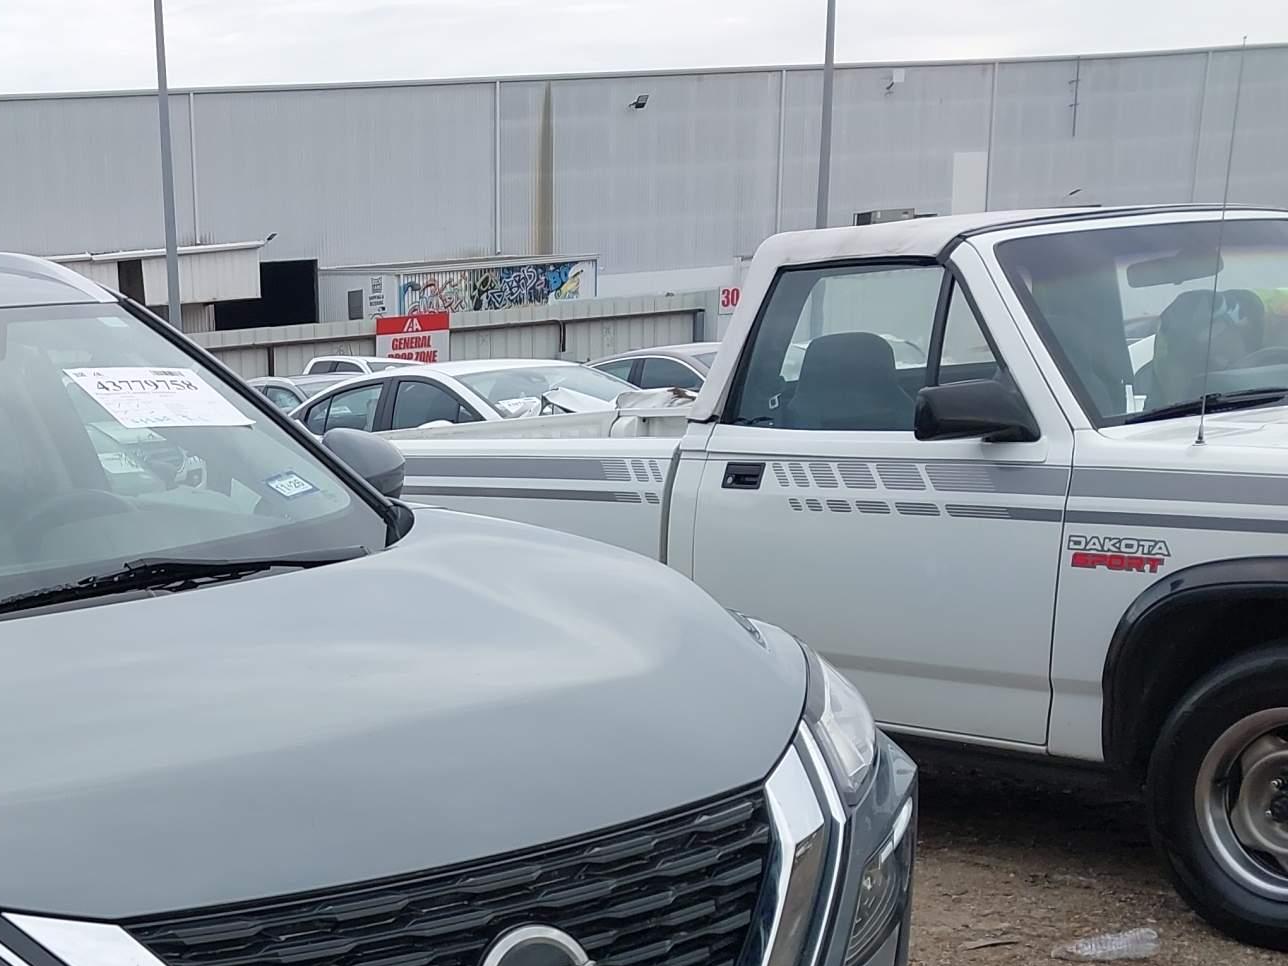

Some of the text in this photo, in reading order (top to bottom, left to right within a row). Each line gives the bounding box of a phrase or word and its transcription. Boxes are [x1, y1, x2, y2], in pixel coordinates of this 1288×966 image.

[721, 287, 740, 307] 30
[392, 335, 431, 351] GENERAL
[414, 350, 438, 363] ZONE
[97, 379, 199, 392] 43779758
[1068, 535, 1171, 557] DAKOTA
[1071, 552, 1165, 574] SPORT
